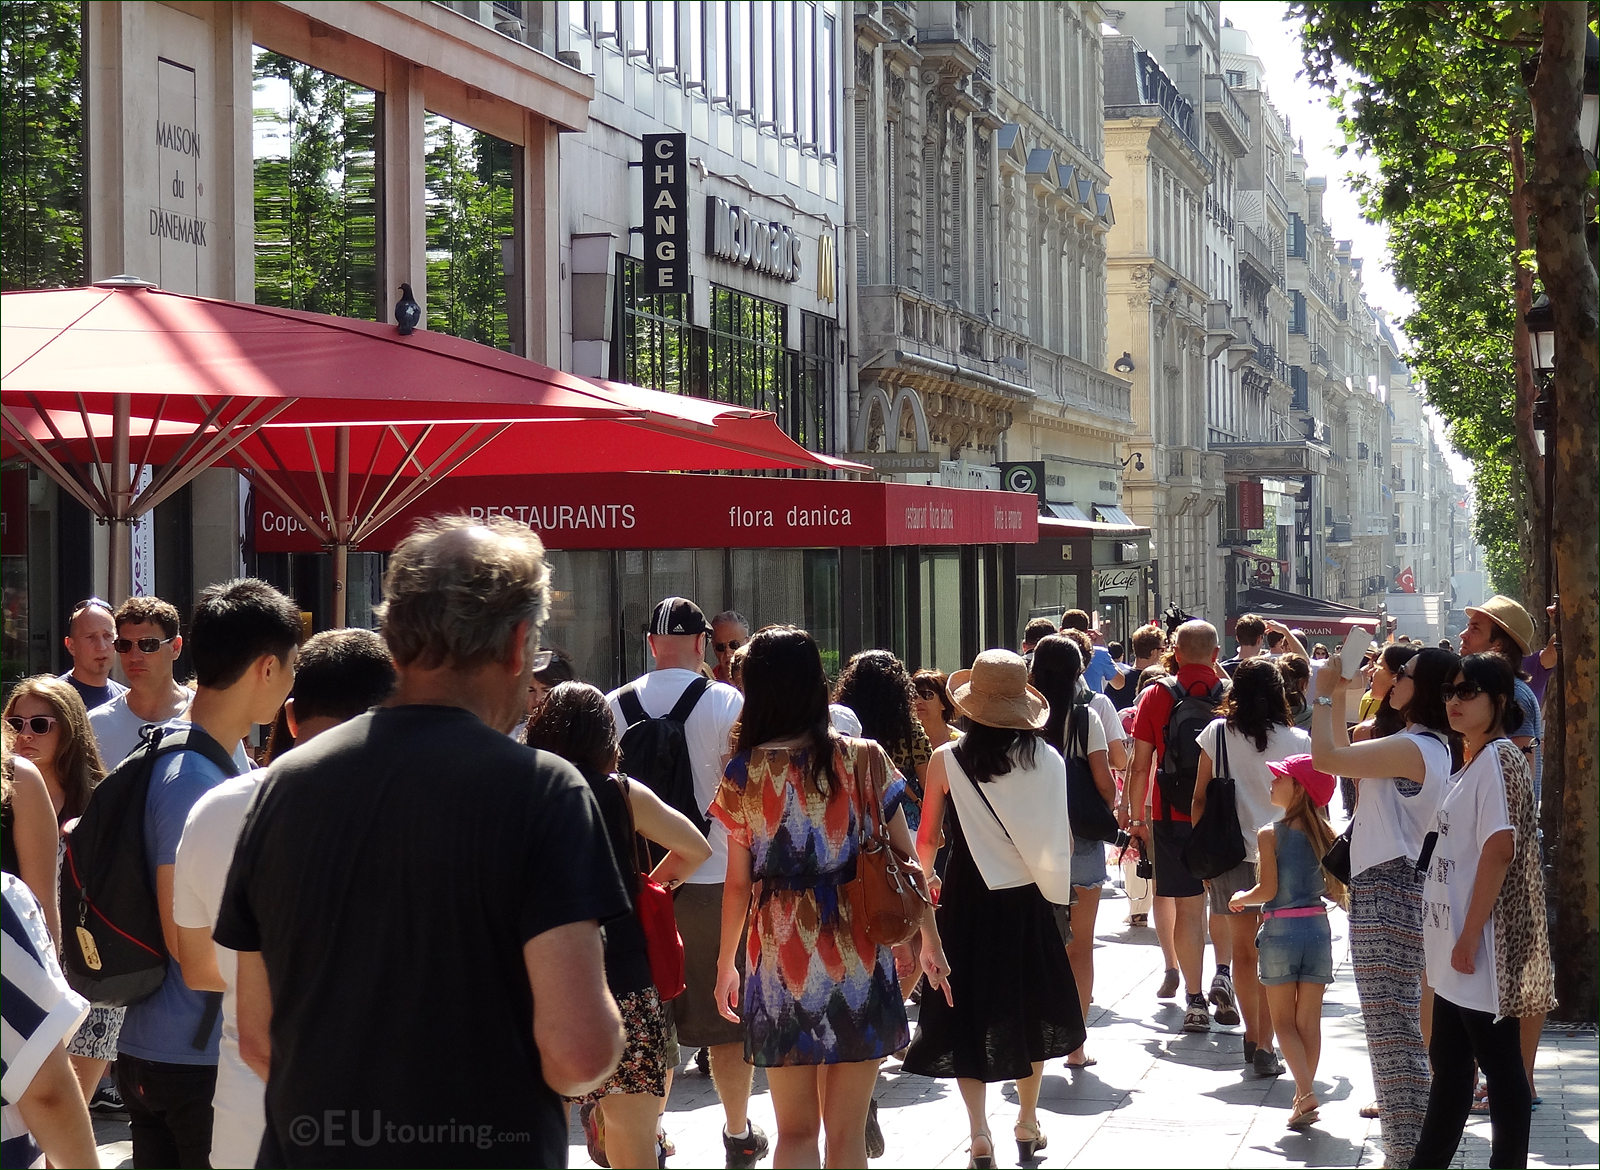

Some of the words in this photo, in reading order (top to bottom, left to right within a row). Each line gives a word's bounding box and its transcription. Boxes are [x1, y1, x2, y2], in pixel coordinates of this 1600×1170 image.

[155, 119, 200, 159] MAISON
[173, 169, 185, 198] du
[149, 208, 207, 247] DANEMARK
[653, 139, 677, 287] CHANGE
[470, 503, 637, 530] RESTAURANTS
[728, 506, 774, 527] flora
[786, 505, 852, 526] danica
